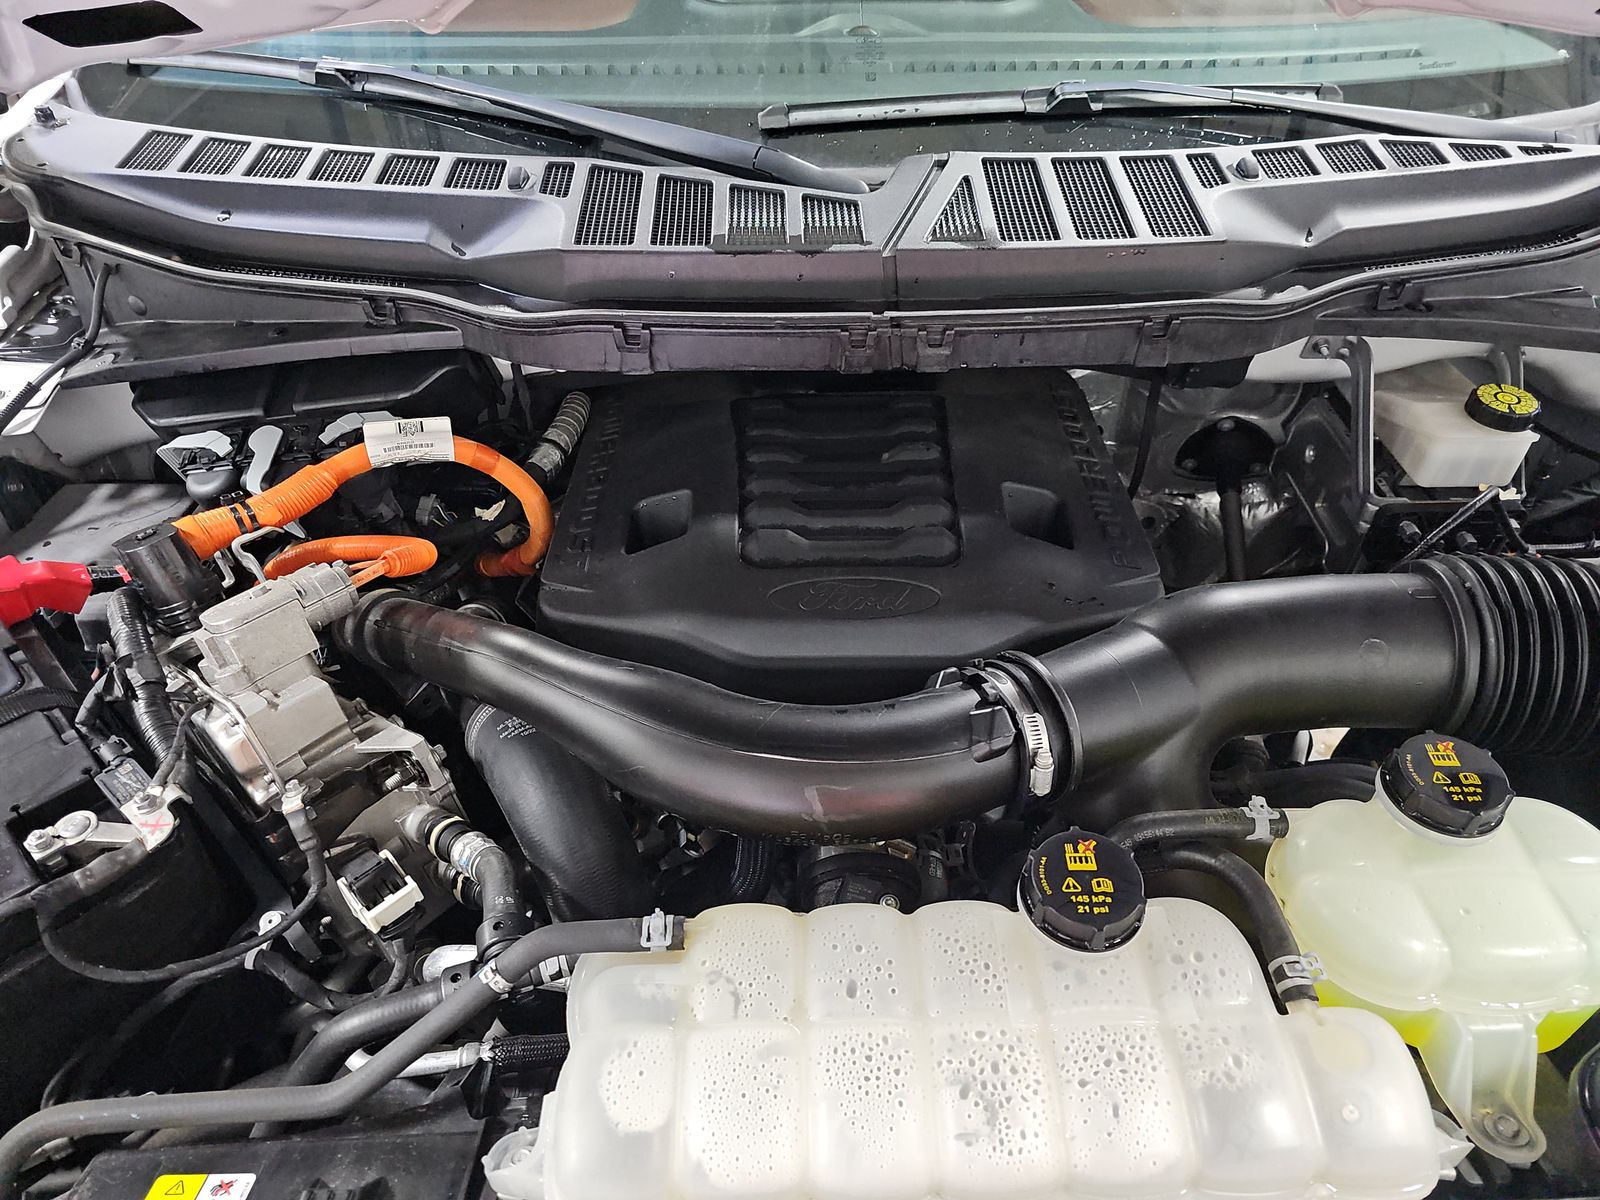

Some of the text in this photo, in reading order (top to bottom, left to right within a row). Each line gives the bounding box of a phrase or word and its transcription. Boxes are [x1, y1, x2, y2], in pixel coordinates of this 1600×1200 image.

[799, 582, 911, 611] Ford
[1467, 794, 1482, 802] psi
[1070, 895, 1112, 903] 145 kPa
[1093, 906, 1109, 914] psi
